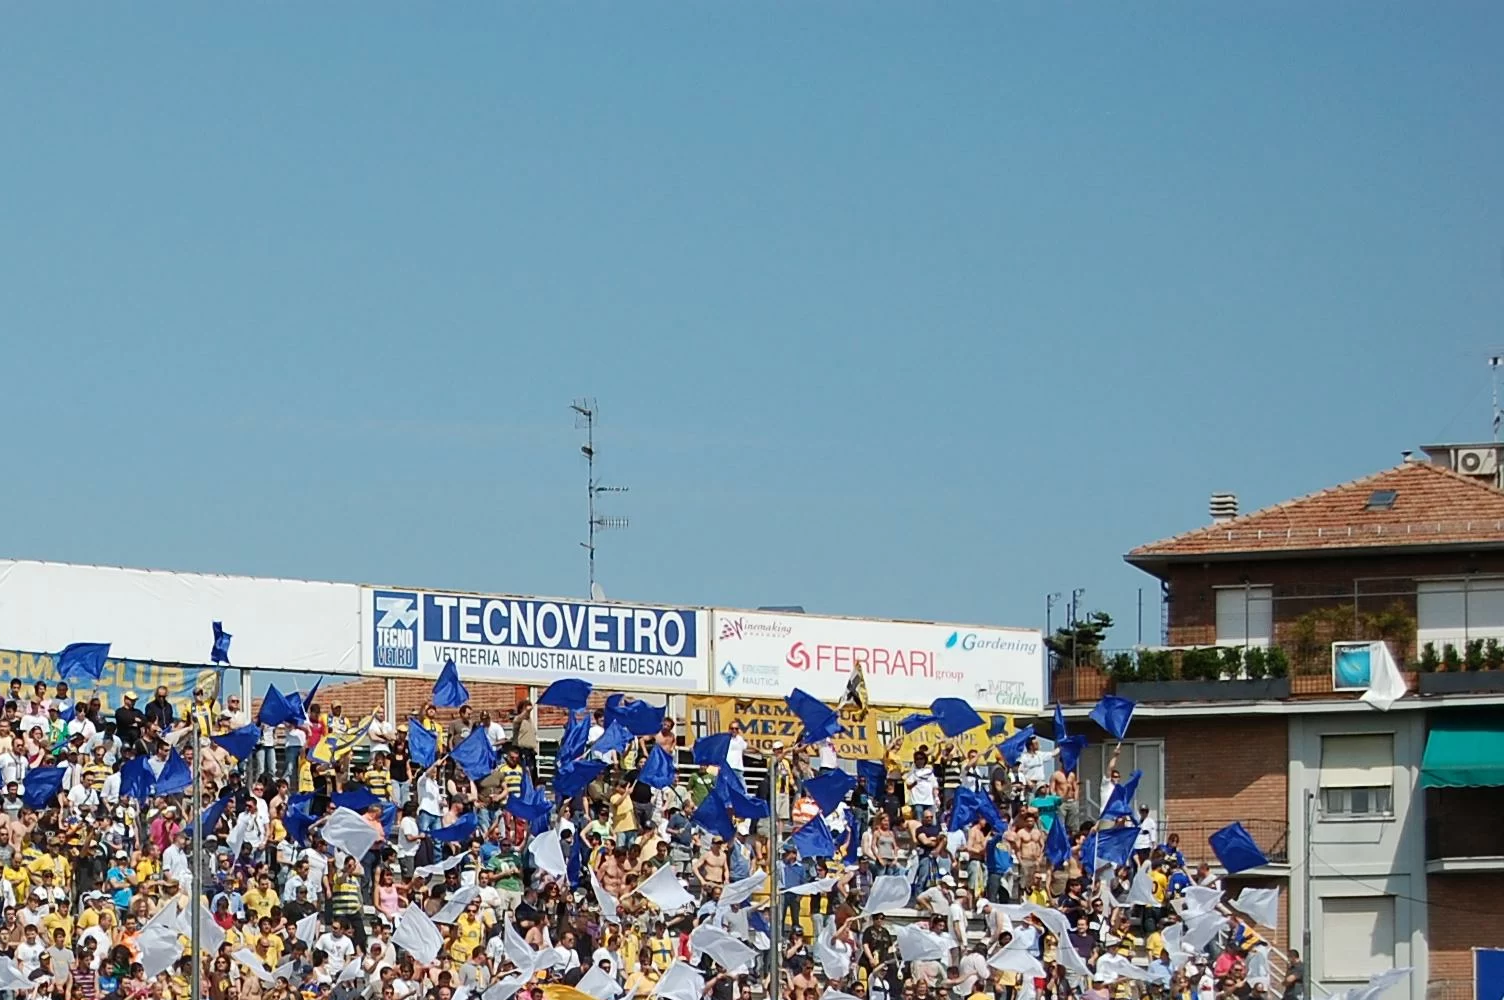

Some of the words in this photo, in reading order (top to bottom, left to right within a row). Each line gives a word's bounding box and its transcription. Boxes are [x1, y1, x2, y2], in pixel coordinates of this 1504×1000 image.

[434, 596, 686, 656] TECNOVETRO
[377, 627, 414, 649] TECNO
[962, 633, 1037, 656] Gardening
[378, 647, 414, 667] VETRO
[433, 645, 500, 666] VETRERIA
[508, 650, 595, 672] INDUSTRIALE
[609, 657, 684, 677] MEDESANO
[816, 645, 934, 677] FERRARI
[935, 671, 964, 682] group
[734, 702, 793, 717] PARM
